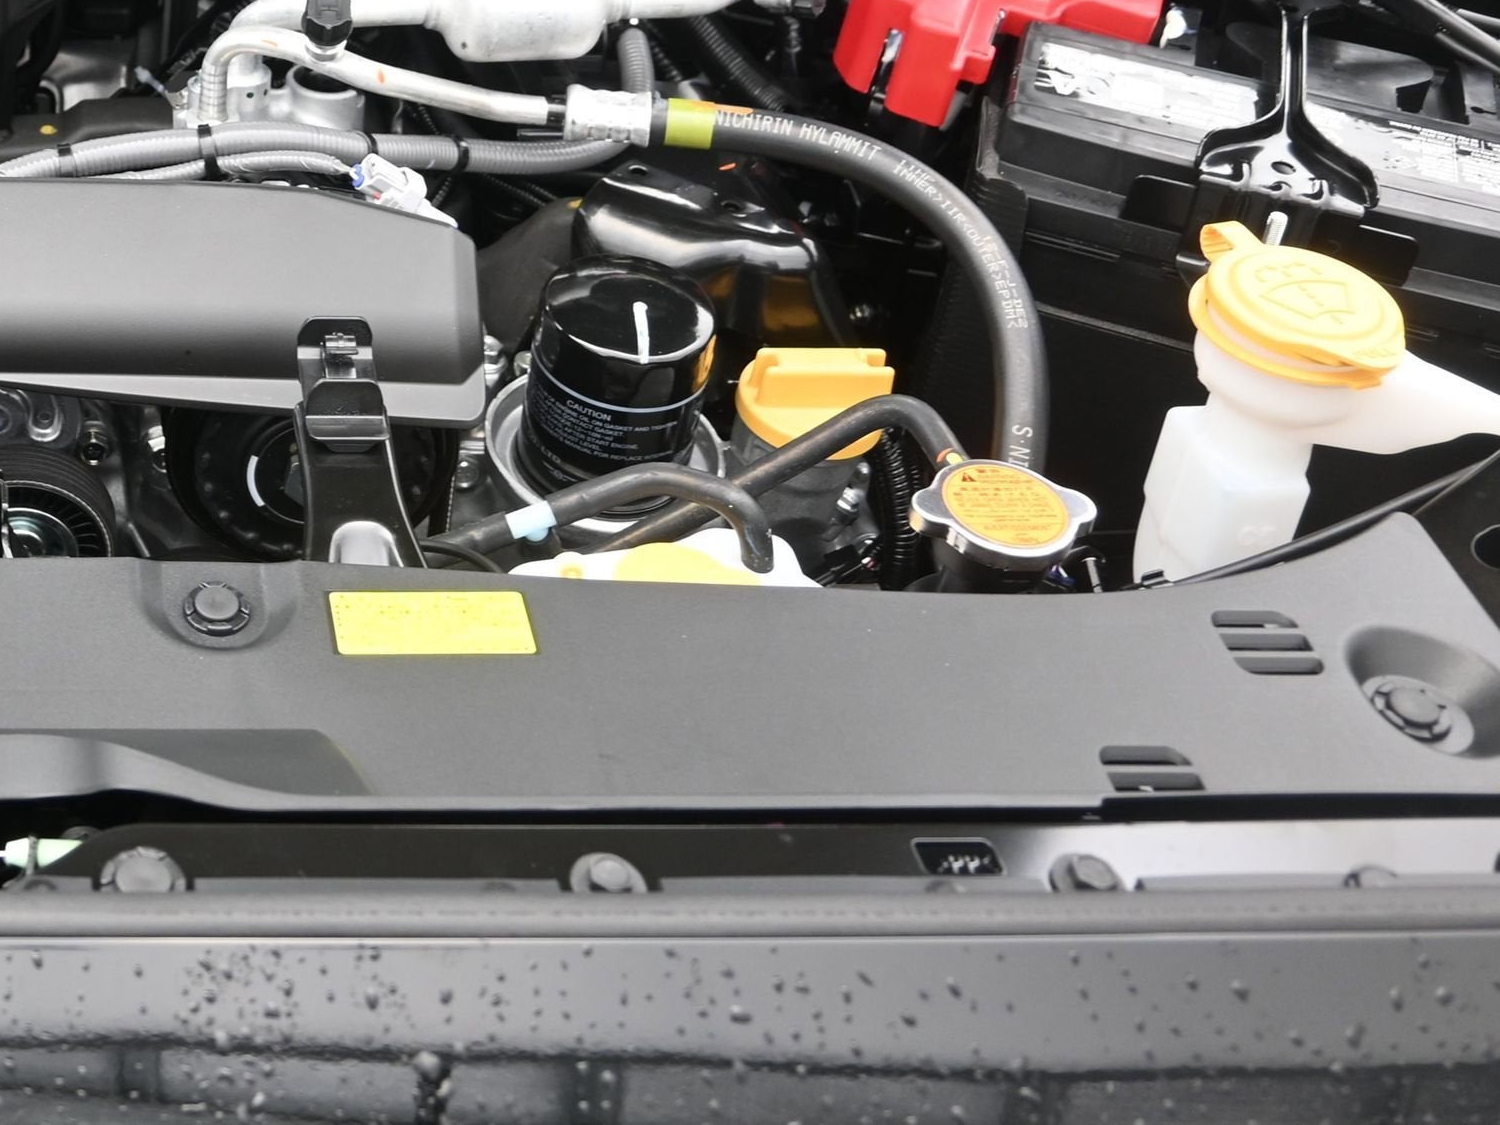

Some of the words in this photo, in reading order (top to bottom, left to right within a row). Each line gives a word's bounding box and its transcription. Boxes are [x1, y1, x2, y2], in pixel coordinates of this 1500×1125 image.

[715, 110, 794, 136] NICHIRIN
[799, 122, 882, 161] HYLAMMIT
[566, 400, 612, 421] CAUTION
